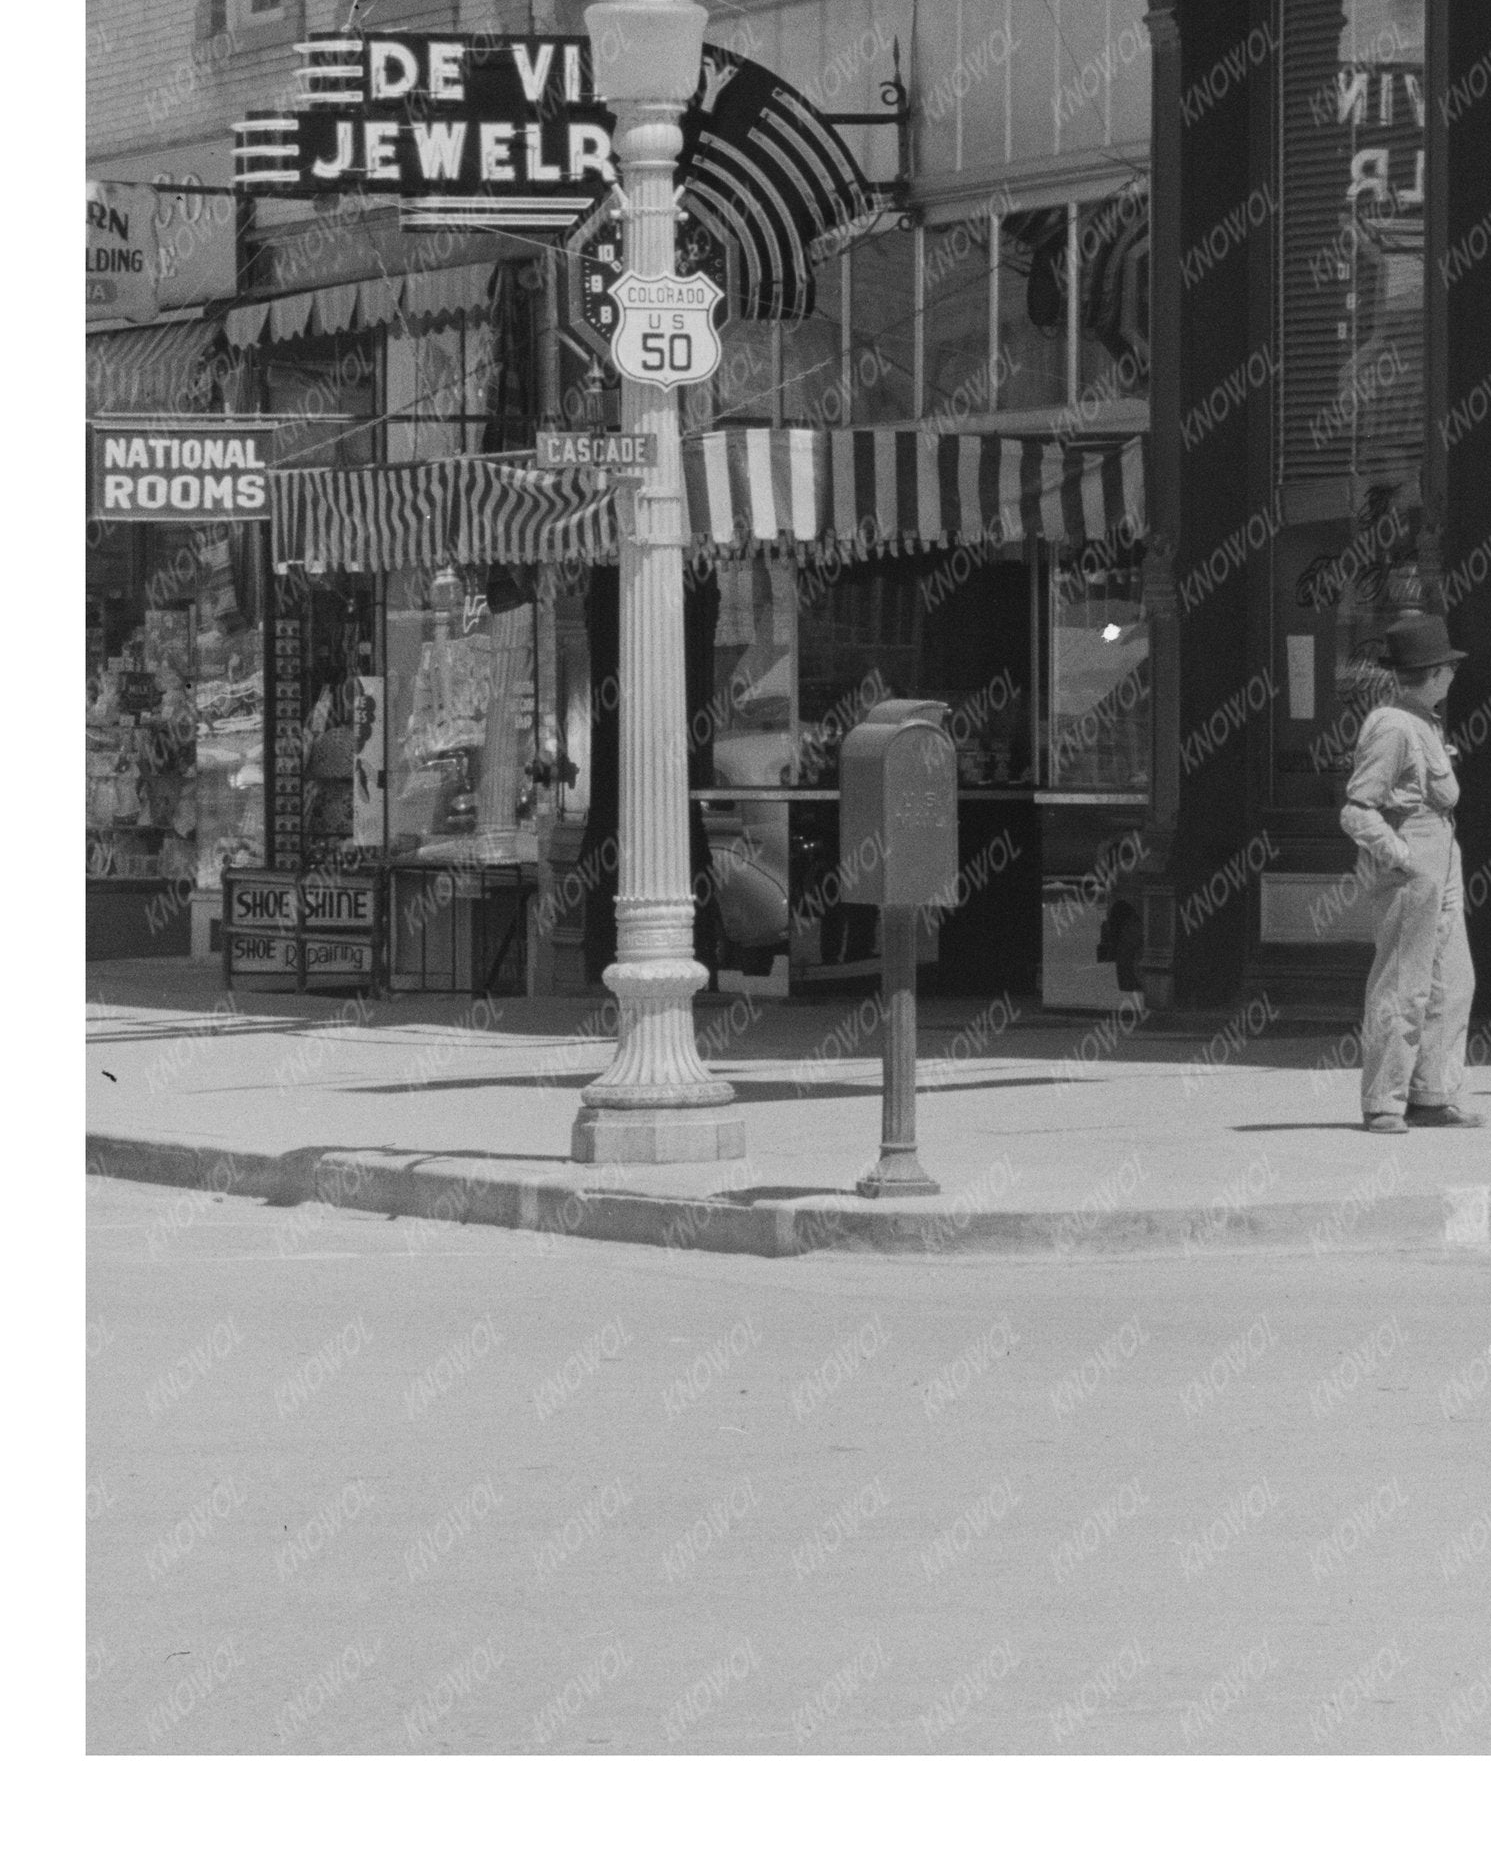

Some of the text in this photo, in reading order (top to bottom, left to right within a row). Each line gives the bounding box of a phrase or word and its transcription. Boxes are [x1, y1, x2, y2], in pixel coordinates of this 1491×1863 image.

[369, 41, 465, 101] DE
[311, 121, 619, 182] JEWELR
[627, 286, 705, 305] COLORADO
[641, 332, 692, 372] 50
[104, 438, 266, 470] NATIONAL
[548, 436, 647, 464] CASCADE
[104, 474, 266, 510] ROOMS
[236, 890, 368, 920] SHOE SHINE
[234, 939, 364, 971] SHOE Rpairing
